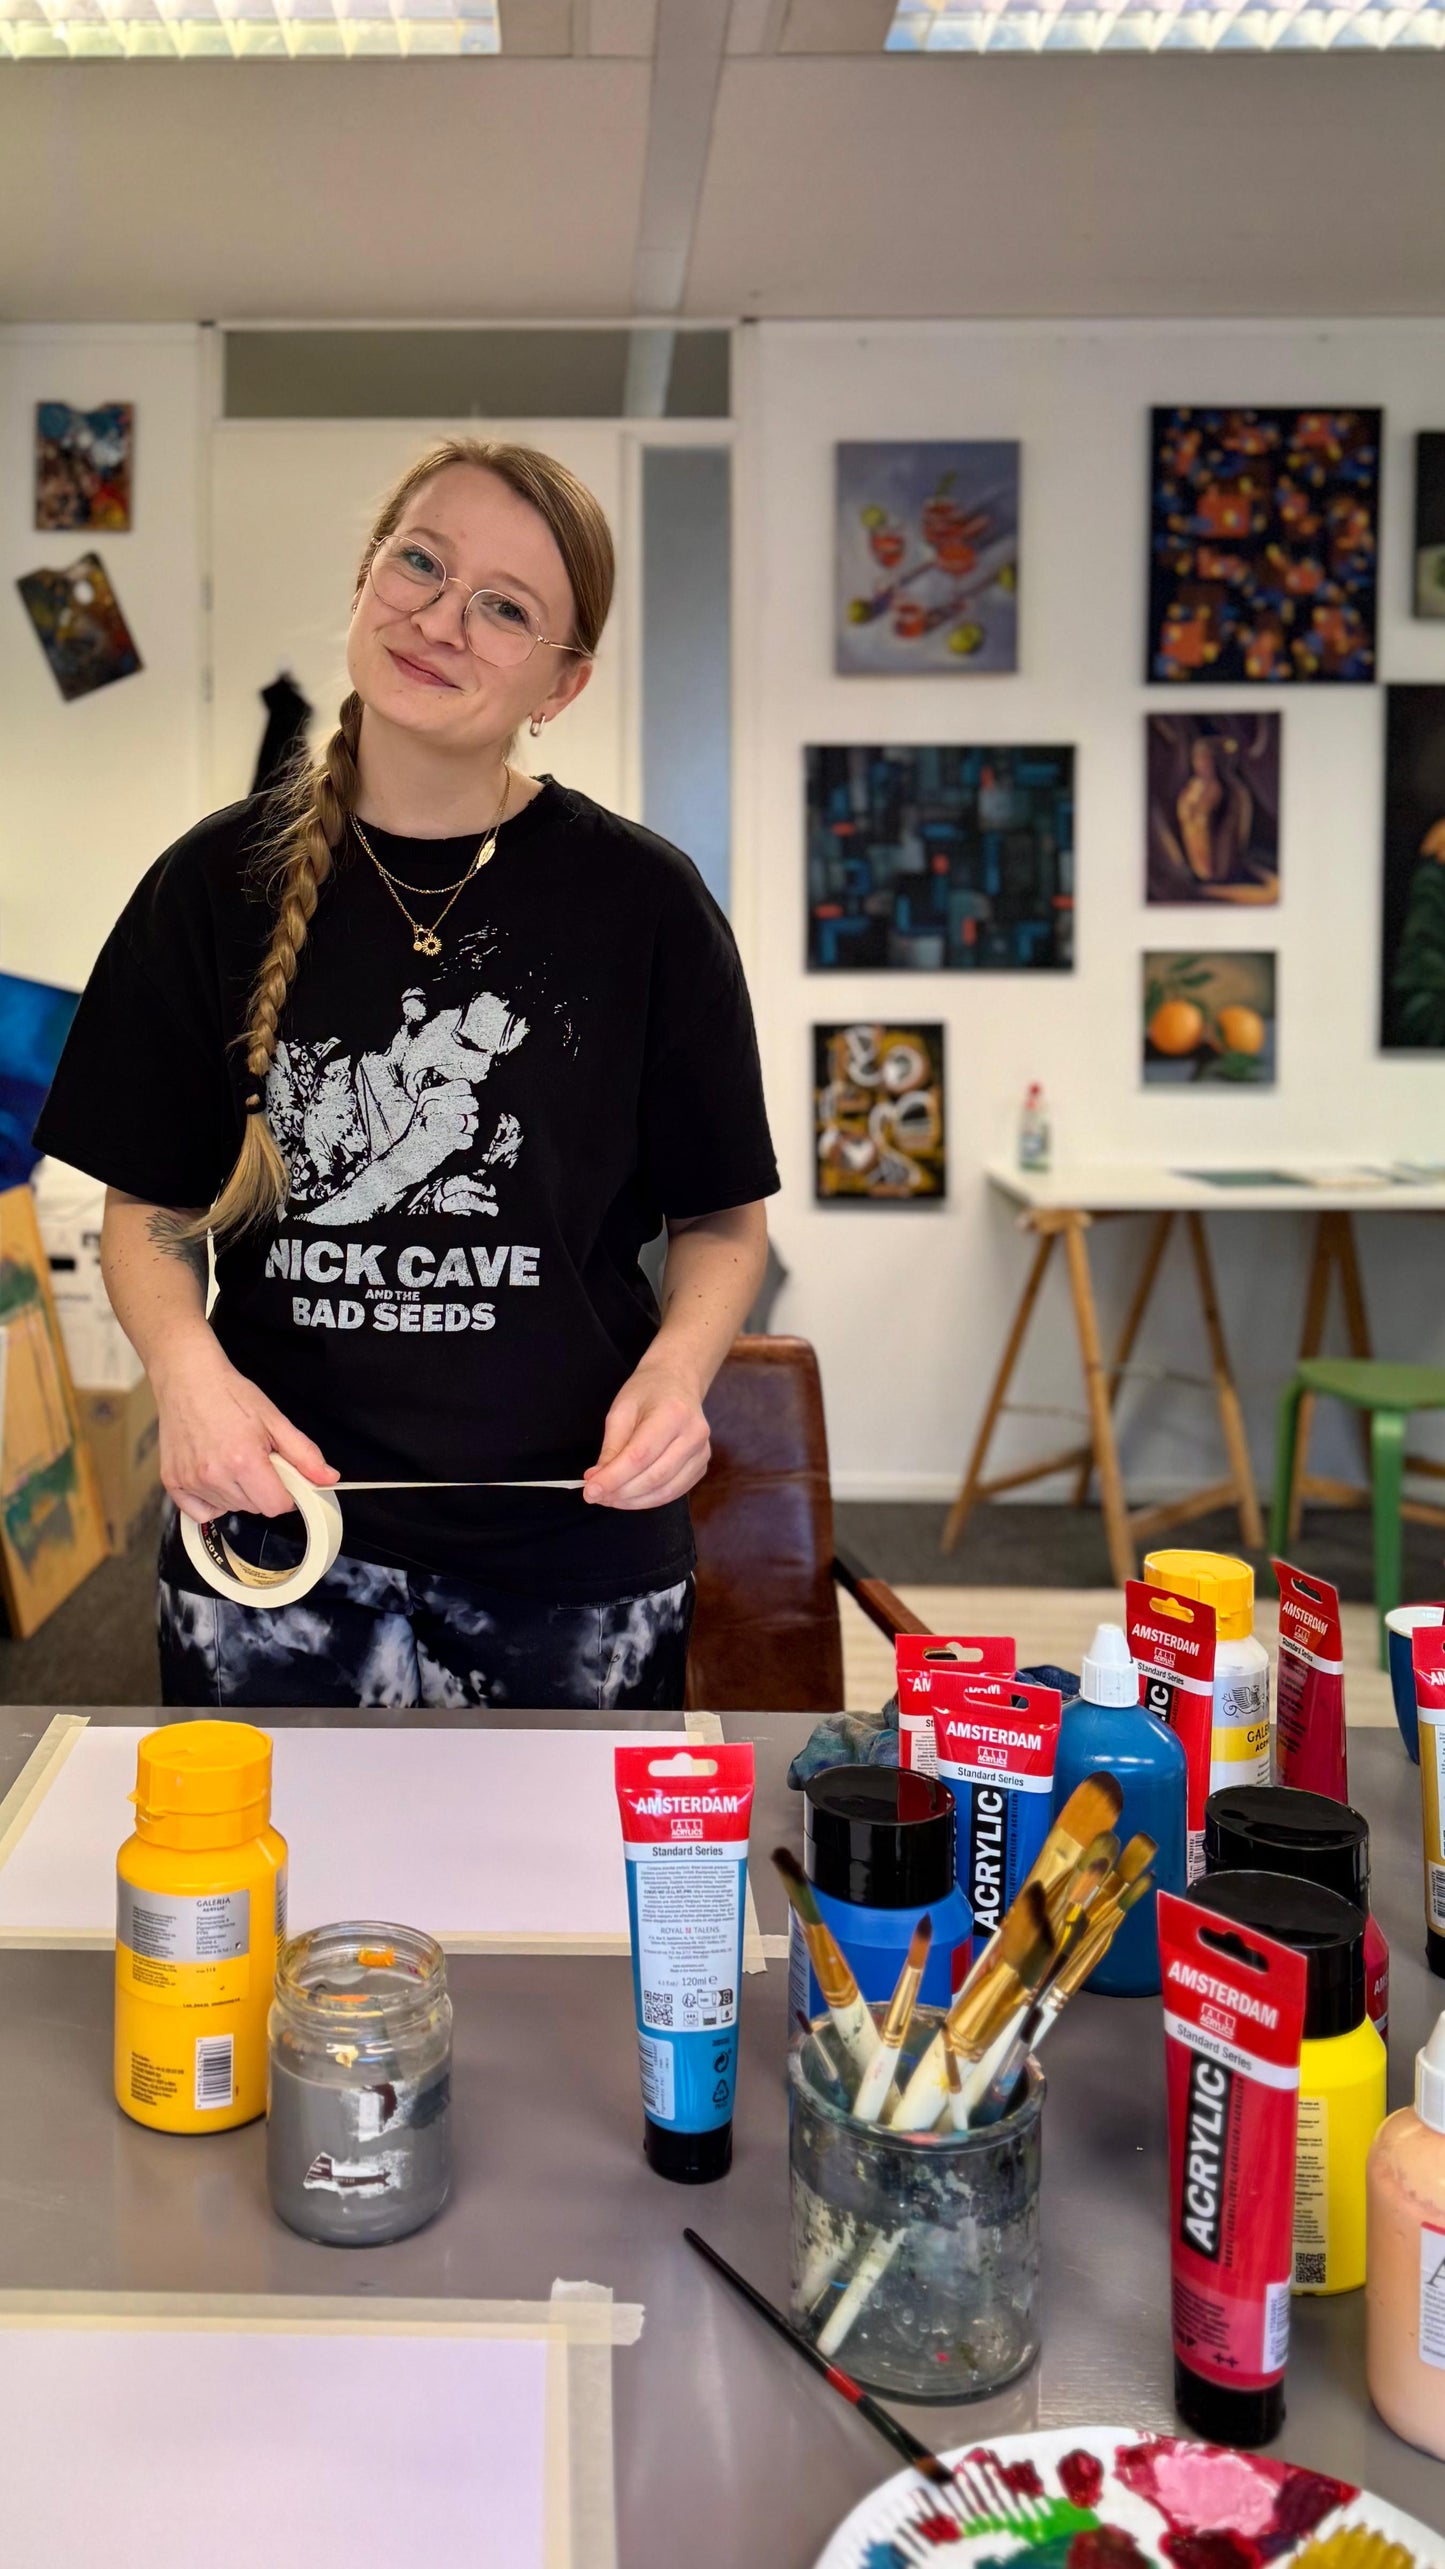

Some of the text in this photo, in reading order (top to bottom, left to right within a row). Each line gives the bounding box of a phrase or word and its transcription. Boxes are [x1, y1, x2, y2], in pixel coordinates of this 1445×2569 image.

[265, 1238, 540, 1288] NICK CAVE
[365, 1289, 420, 1301] AND THE
[292, 1297, 495, 1332] BAD SEEDS
[1282, 1601, 1329, 1636] AMSTERDAM
[1131, 1623, 1200, 1657] AMSTERDAM
[1137, 1662, 1184, 1685] Standard Series
[946, 1721, 1041, 1750] AMSTERDAM
[957, 1767, 1024, 1786] Standard Series
[636, 1796, 738, 1815] AMSTERDAM
[652, 1845, 723, 1856] Standard Series
[974, 1790, 1003, 1932] ACRYLIC
[196, 1898, 231, 1907] GALERIA
[660, 1926, 720, 1935] ROYAL TALENS
[682, 1977, 707, 1986] 120ml
[1168, 1960, 1279, 2030] AMSTERDAM
[1177, 2024, 1252, 2071] Standard Series
[1185, 2063, 1226, 2251] ACRYLIC
